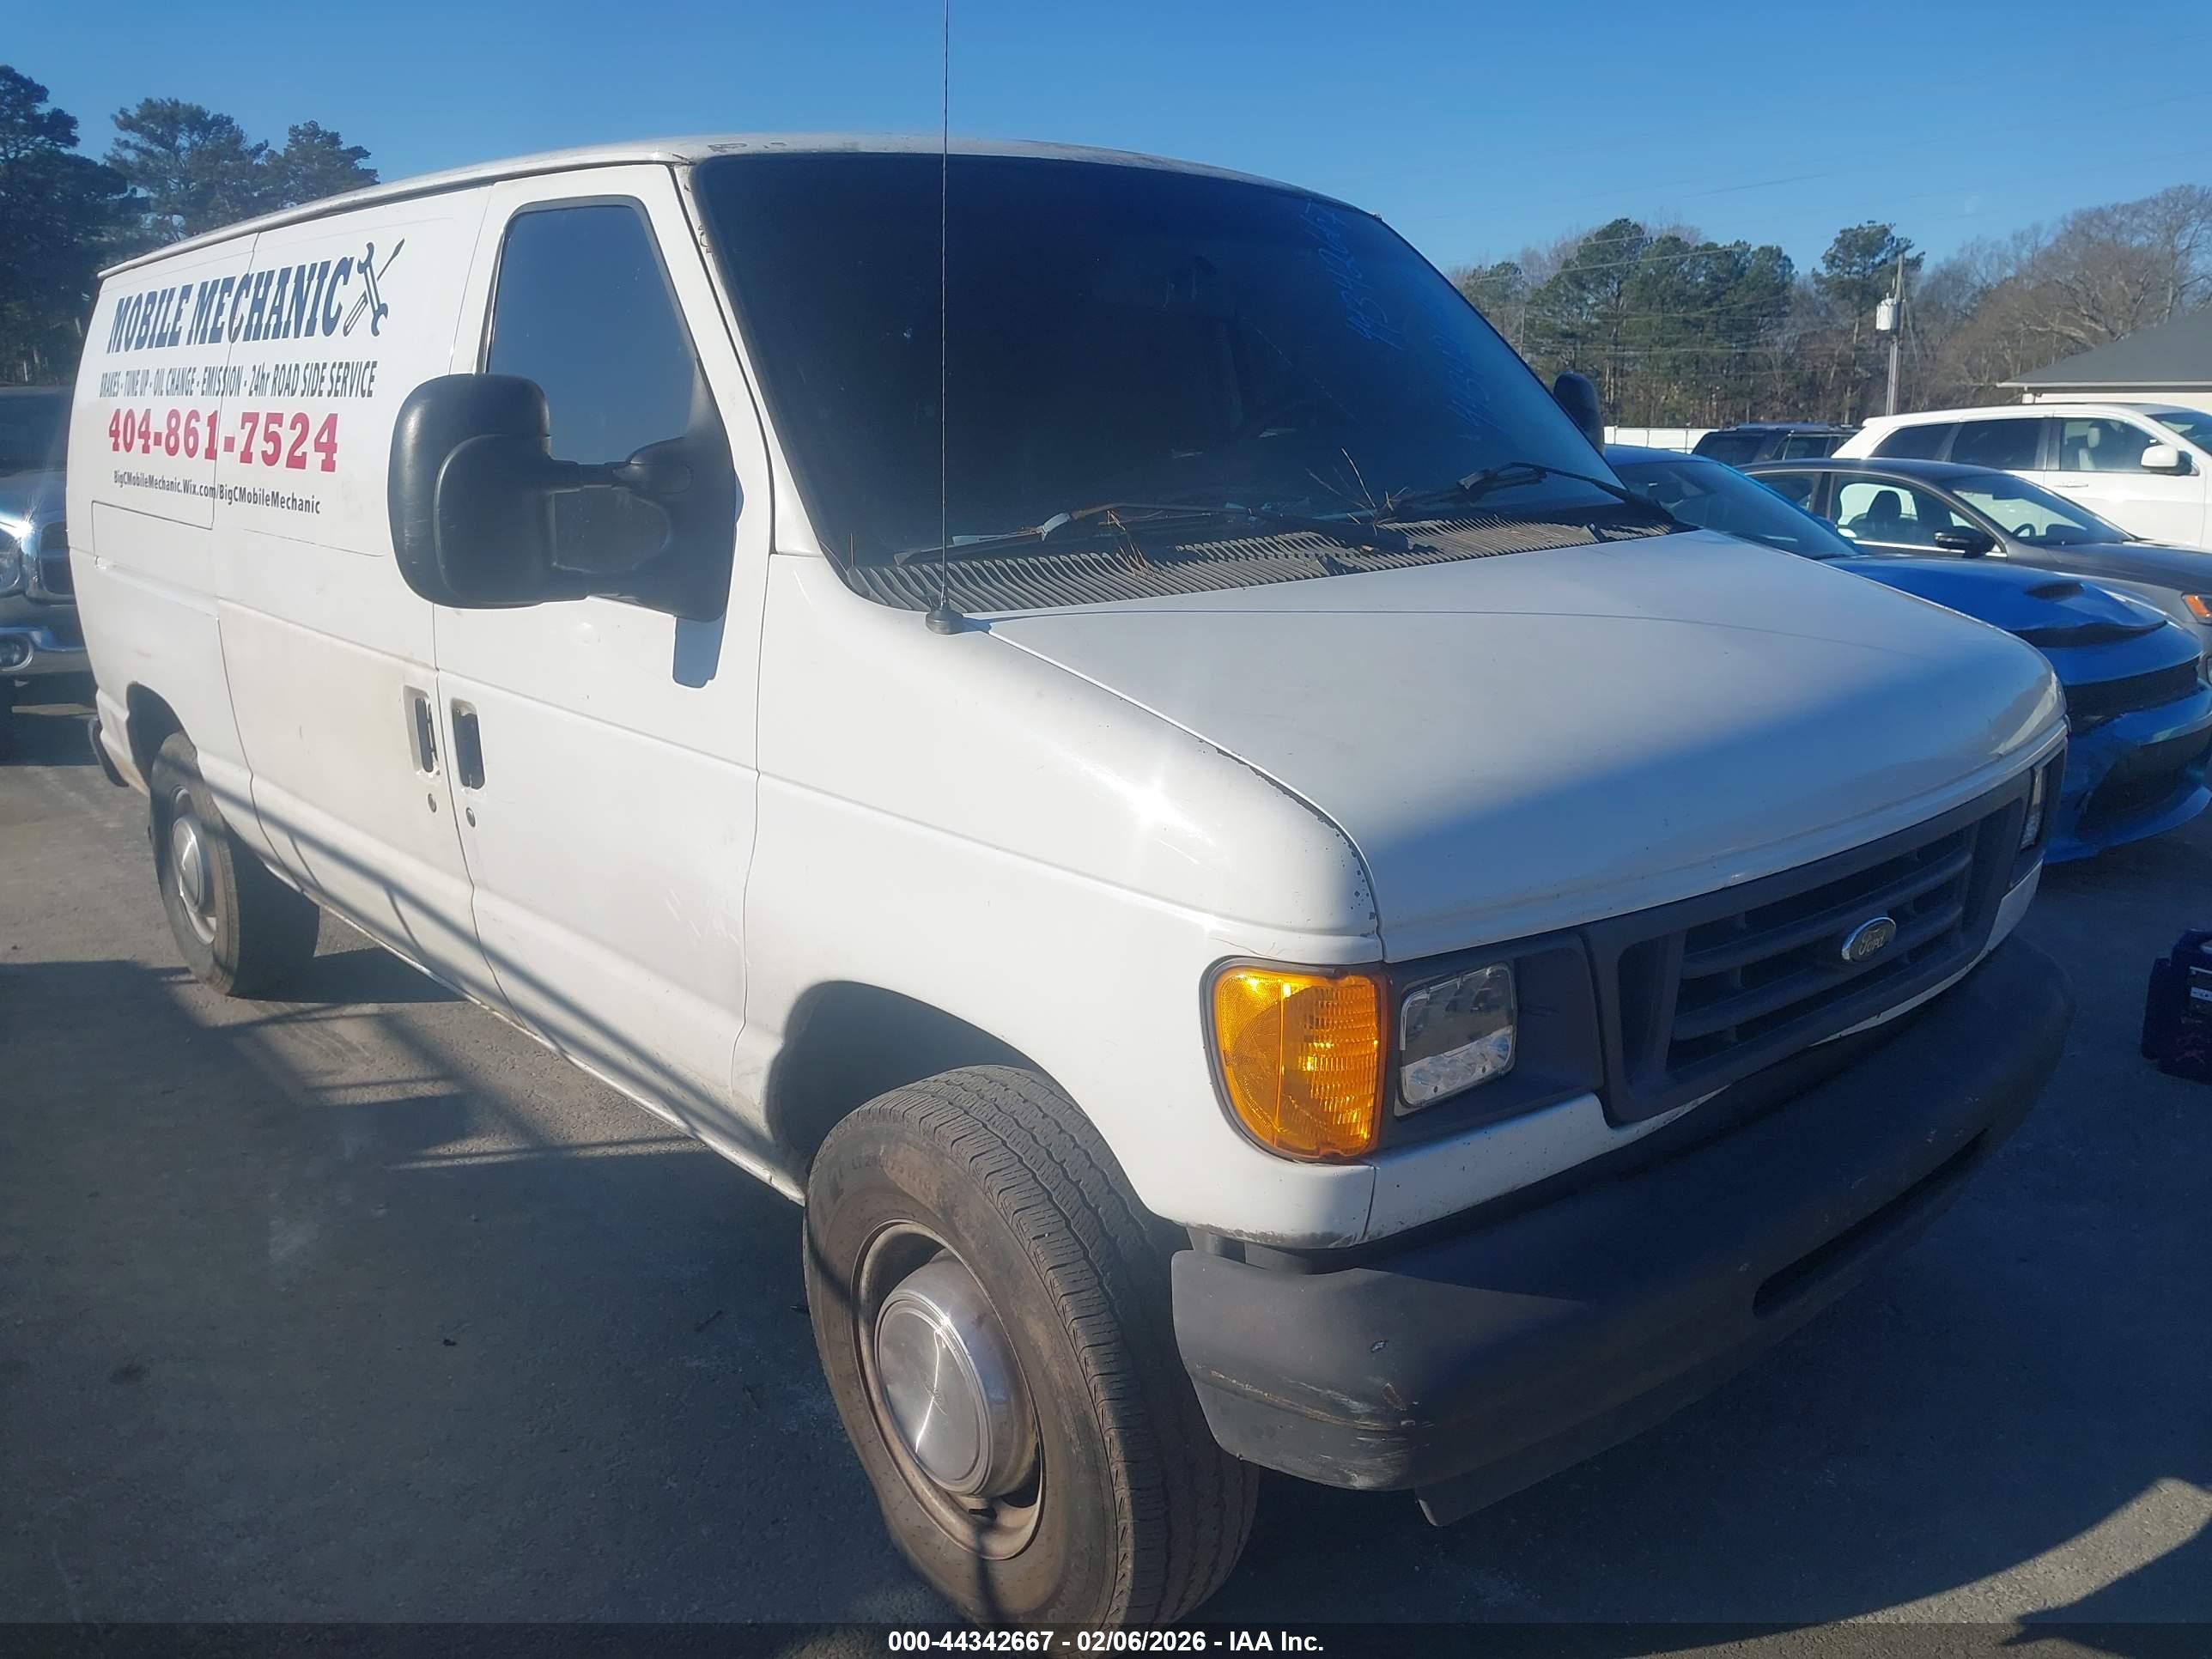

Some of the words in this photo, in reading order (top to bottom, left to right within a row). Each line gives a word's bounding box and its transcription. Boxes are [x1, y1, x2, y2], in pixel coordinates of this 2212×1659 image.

[106, 283, 194, 354] MOBILE
[185, 256, 355, 345] MECHANIC
[99, 371, 122, 398] BRAKES
[124, 370, 141, 398] TUNE
[139, 369, 150, 398] UP
[154, 368, 165, 397] OIL
[166, 367, 198, 397] CHANGE
[201, 365, 244, 398] EMISSION
[248, 362, 270, 398] 24hr
[270, 362, 301, 398] ROAD
[301, 362, 328, 398] SIDE
[327, 361, 378, 398] SERVICE
[108, 408, 338, 472] 404-861-7524
